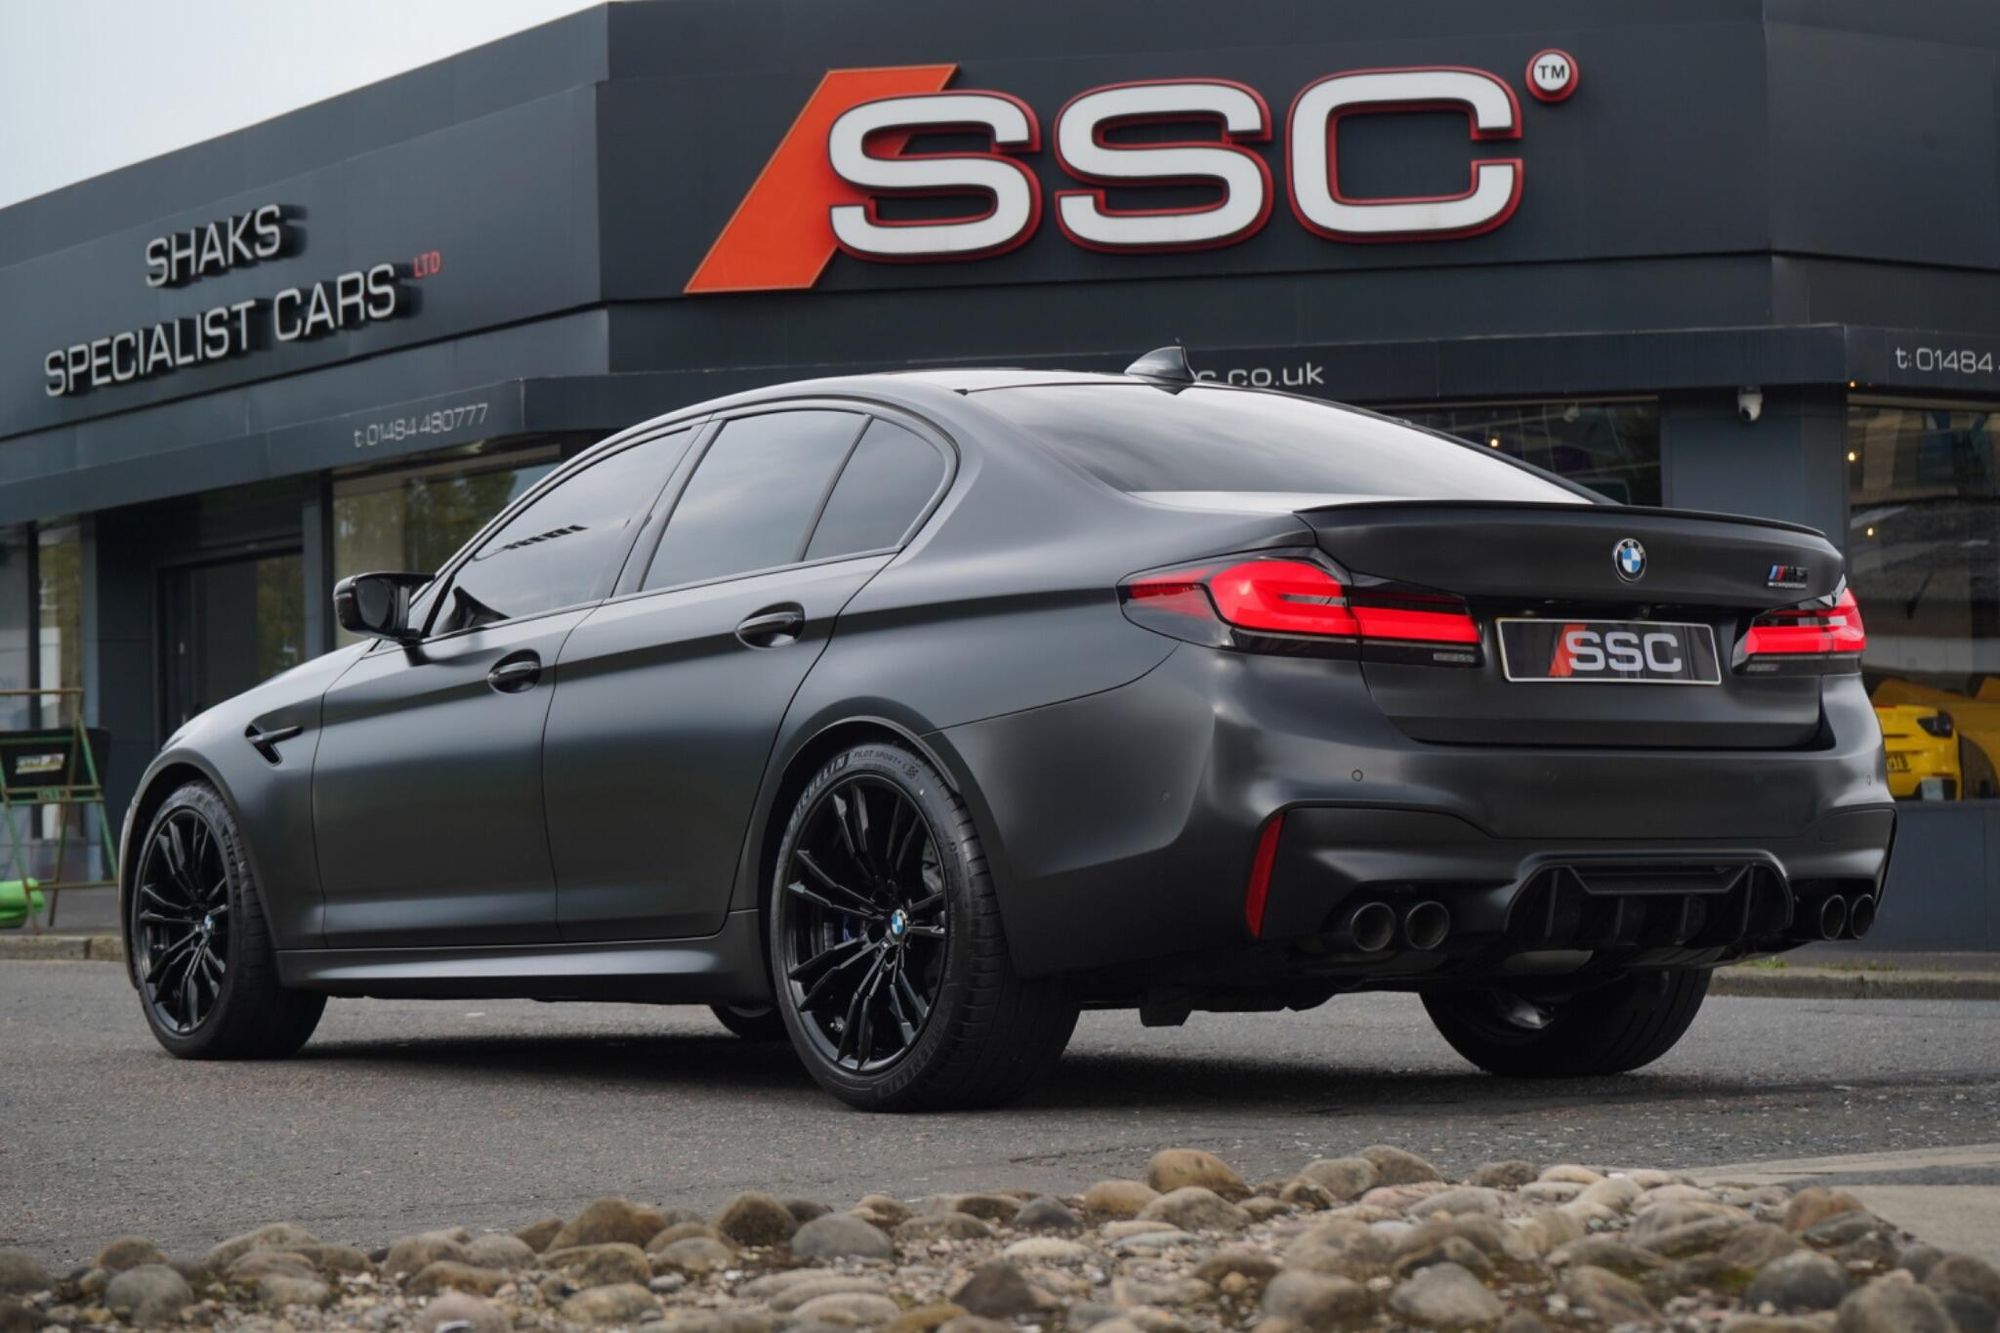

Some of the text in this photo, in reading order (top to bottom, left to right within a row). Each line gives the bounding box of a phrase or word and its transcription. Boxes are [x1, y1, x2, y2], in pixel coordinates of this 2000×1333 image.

[1538, 64, 1566, 80] TM
[827, 66, 1521, 260] SSC
[146, 204, 281, 288] SHAKS
[45, 251, 441, 397] SPECIALIST CARS LTD
[419, 402, 488, 434] 480777
[1566, 630, 1682, 673] SSC
